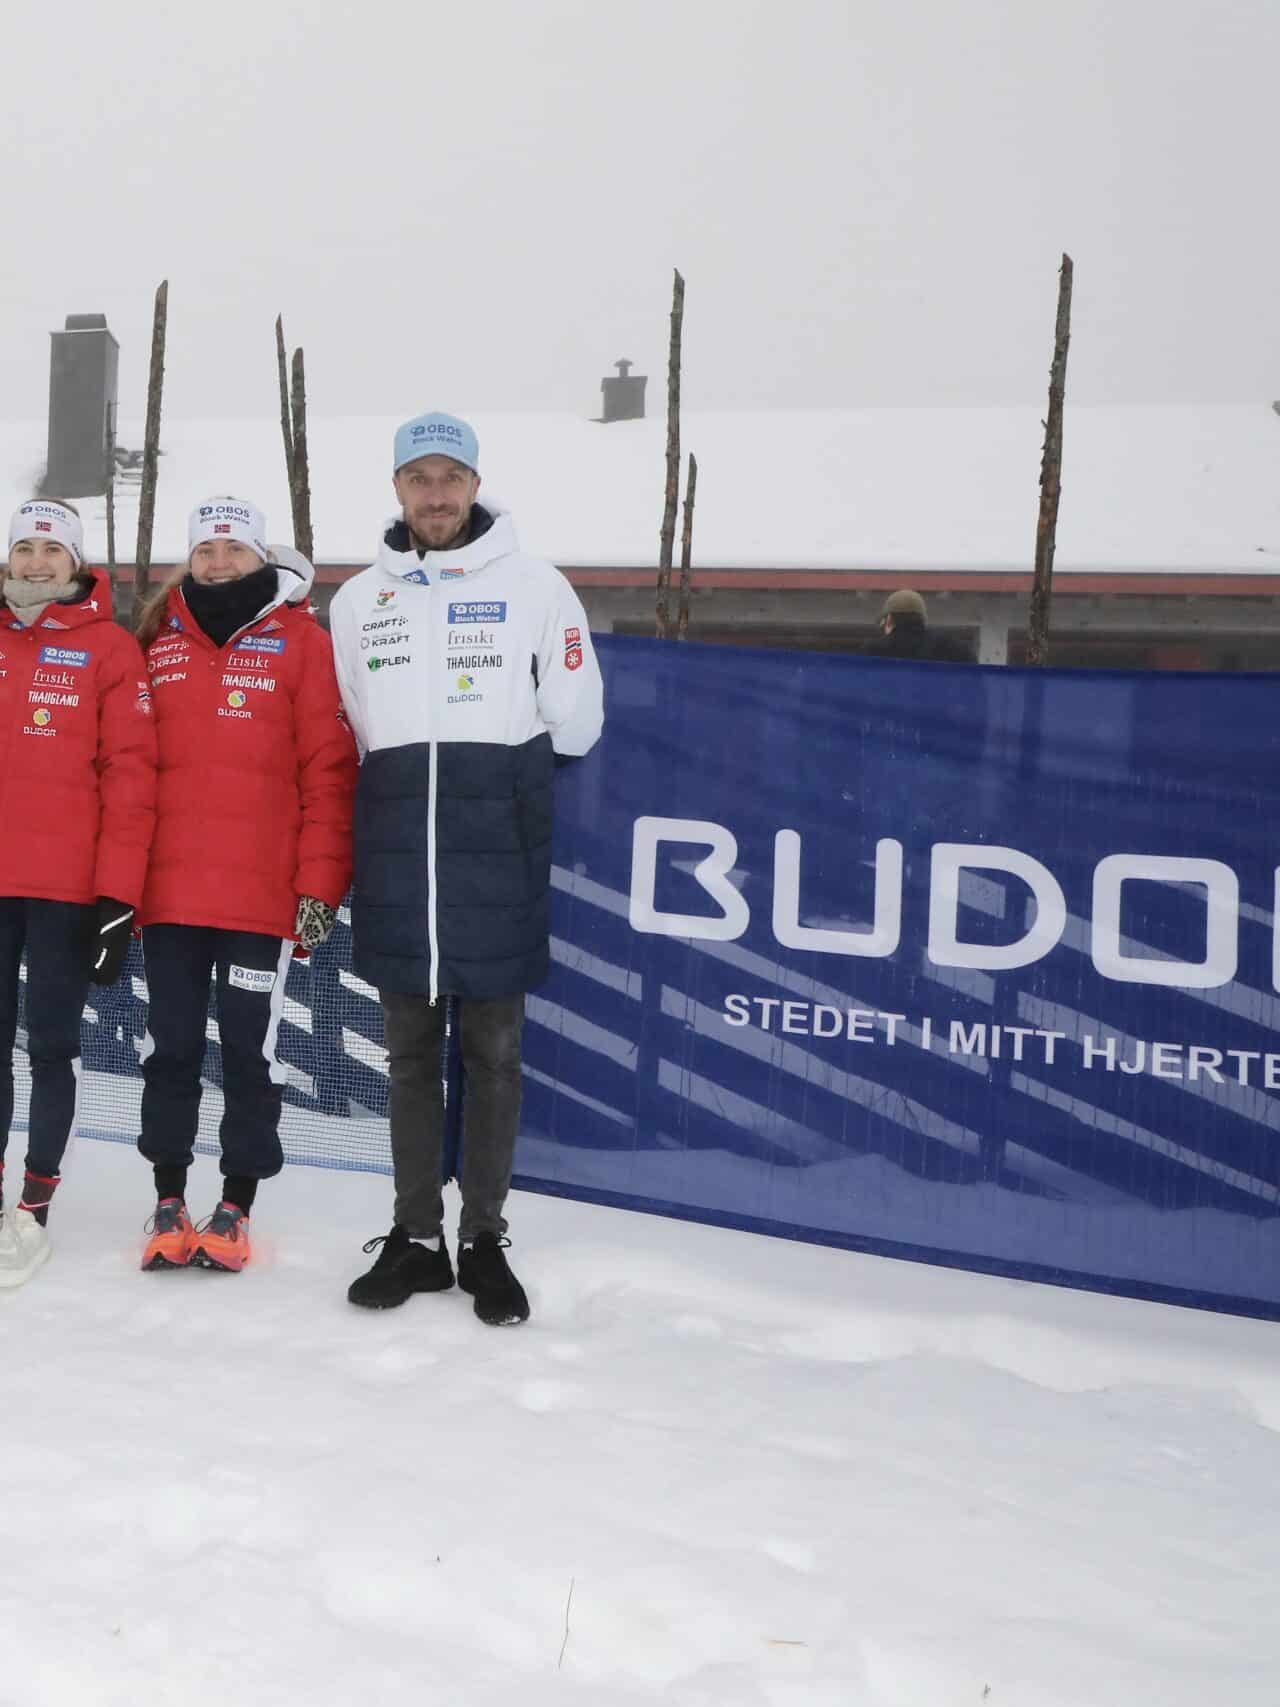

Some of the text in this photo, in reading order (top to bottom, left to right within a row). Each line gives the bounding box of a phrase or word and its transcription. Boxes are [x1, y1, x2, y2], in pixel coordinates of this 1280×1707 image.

[427, 424, 462, 437] OBOS
[35, 505, 66, 518] OBOS
[216, 505, 249, 518] OBOS
[469, 604, 500, 613] OBOS
[363, 618, 398, 632] CRAFT
[253, 638, 280, 648] OBOS
[372, 634, 409, 647] KRAFT
[448, 629, 495, 645] frisikt
[58, 650, 86, 660] OBOS
[149, 643, 179, 656] CRAFT
[157, 655, 190, 669] KRAFT
[227, 653, 269, 669] frisikt
[367, 655, 411, 669] VEFLEN
[447, 655, 502, 670] THAUGLAND
[34, 668, 75, 686] frisikt
[222, 674, 276, 692] THAUGLAND
[28, 690, 79, 707] THAUGLAND
[448, 694, 483, 703] BUDOR
[218, 708, 252, 719] BUDOR
[23, 726, 56, 736] BUDOR
[629, 816, 1280, 993] BUDO
[246, 971, 272, 982] OBOS
[723, 994, 906, 1047] STEDET
[922, 1017, 932, 1049] I
[948, 1021, 1066, 1065] MITT
